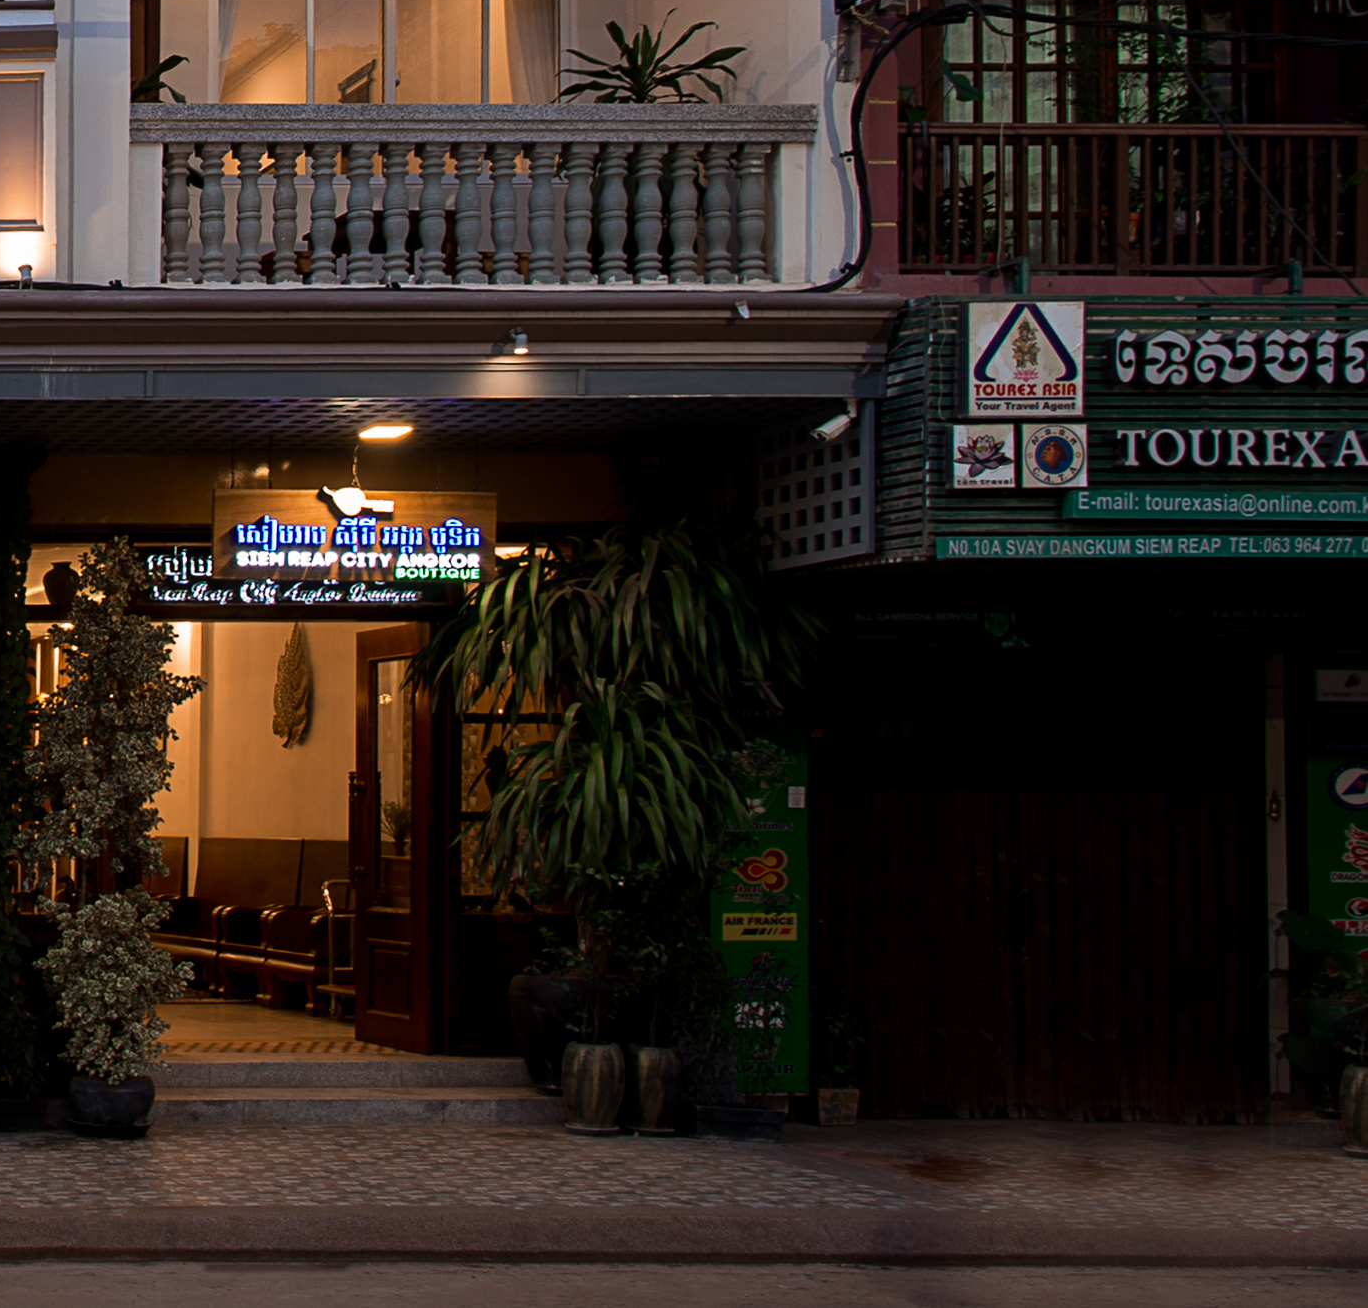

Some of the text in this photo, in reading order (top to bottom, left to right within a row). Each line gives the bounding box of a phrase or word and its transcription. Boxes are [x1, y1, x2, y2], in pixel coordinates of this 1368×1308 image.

[973, 383, 1078, 397] TOUREX ASIA
[974, 401, 1077, 412] Your Travel Agent
[1116, 428, 1327, 469] TOUREX
[979, 477, 1014, 486] travel
[1077, 491, 1140, 512] E-mail:
[1006, 539, 1047, 555] SVAY
[1049, 538, 1132, 555] DANGKUM
[1135, 538, 1174, 555] SIEM
[1177, 537, 1223, 555] REAP
[1229, 537, 1291, 554] TEL:063
[1294, 537, 1323, 553] 964
[1325, 537, 1358, 556] 277,
[235, 551, 481, 569] SIEM REAP CITY ANGKOR
[395, 568, 481, 580] BOUTIQUE
[724, 916, 795, 926] AIR FRANCE
